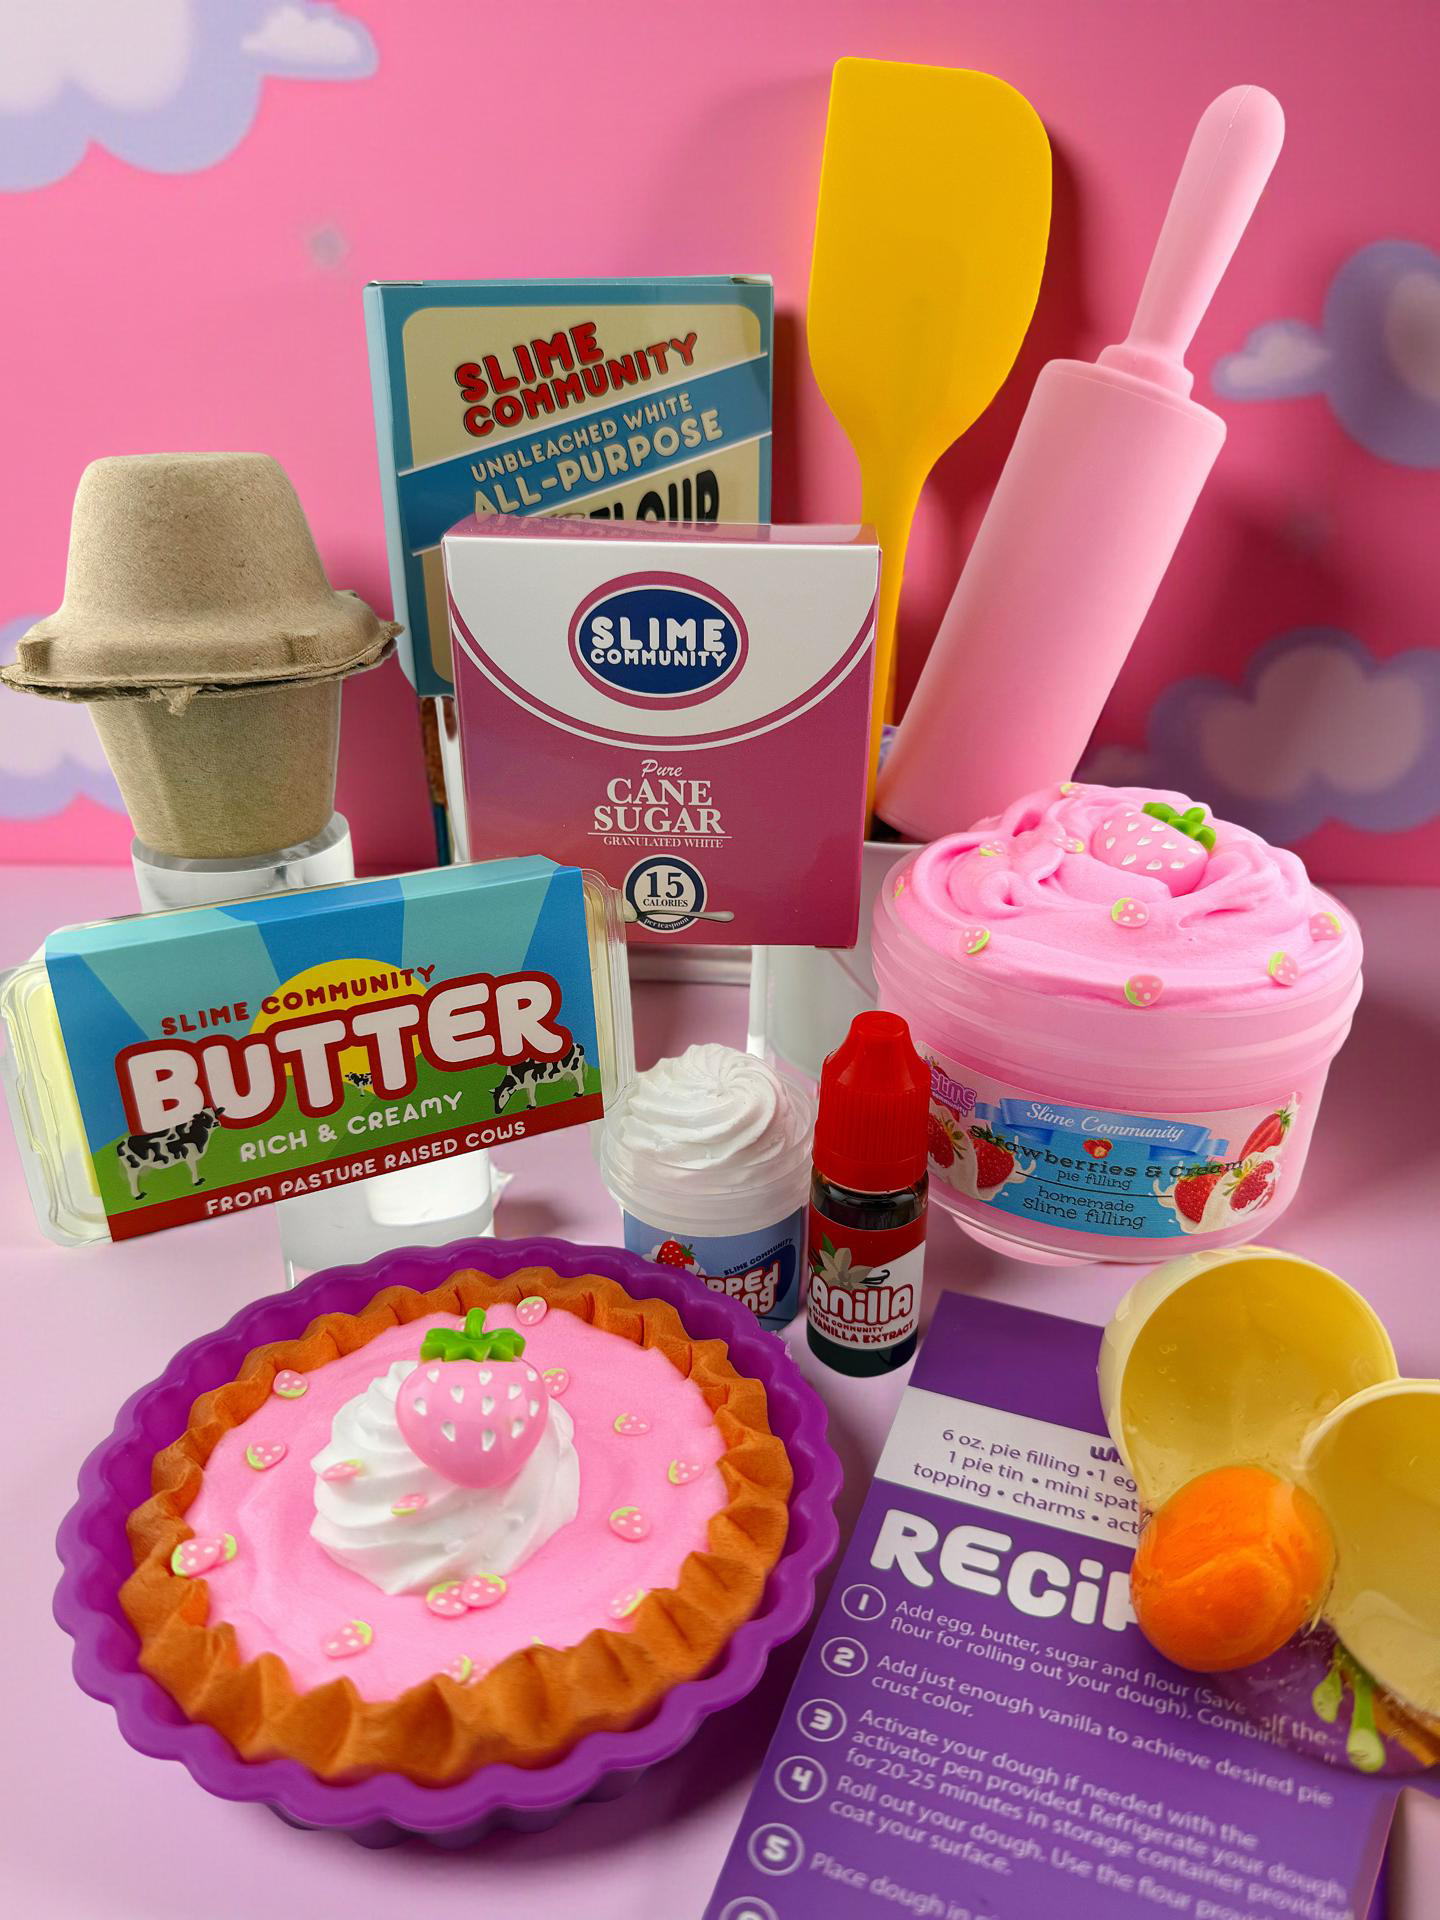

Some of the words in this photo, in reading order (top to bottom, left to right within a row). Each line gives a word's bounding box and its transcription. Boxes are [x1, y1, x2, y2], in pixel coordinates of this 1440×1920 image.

[455, 322, 604, 403] SLIME
[464, 332, 698, 437] COMMUNITY
[471, 419, 618, 483] UNBLEACHED
[623, 393, 693, 431] WHITE
[474, 409, 723, 522] ALL-PURPOSE
[591, 616, 726, 652] SLIME
[591, 648, 727, 668] COMMUNITY
[606, 777, 712, 806] CANE
[641, 758, 683, 778] Pure
[593, 805, 726, 834] SUGAR
[603, 836, 681, 848] GRANULATED
[684, 838, 723, 849] WHITE
[643, 898, 689, 907] CALORIES
[646, 871, 685, 899] 15
[644, 917, 657, 928] per
[657, 916, 690, 930] teaspoon
[162, 1001, 249, 1036] SLIME
[261, 964, 438, 1015] COMMUNITY
[122, 976, 567, 1135] BUTTER
[240, 1128, 308, 1163] RICH
[318, 1119, 336, 1141] &
[346, 1091, 464, 1135] CREAMY
[969, 1124, 1139, 1178] Strawberries
[1145, 1164, 1163, 1178] &
[1169, 1159, 1244, 1179] Cream
[1026, 1102, 1075, 1129] Slime
[1080, 1116, 1186, 1142] Community
[205, 1185, 273, 1216] FROM
[280, 1158, 377, 1197] PASTURE
[384, 1138, 458, 1170] RAISED
[465, 1121, 527, 1150] COWS
[1037, 1185, 1135, 1212] homemade
[1056, 1169, 1081, 1184] pie
[1085, 1172, 1134, 1191] filling
[1022, 1197, 1079, 1222] slime
[1085, 1207, 1147, 1231] filling
[723, 1262, 748, 1276] SLIME
[750, 1238, 794, 1264] COMMUNITY
[812, 1304, 830, 1322] SLIME
[831, 1319, 884, 1333] COMMUNITY
[813, 1315, 859, 1343] VANILLA
[862, 1319, 914, 1344] EXTRACT
[942, 1429, 954, 1442] 6
[958, 1434, 986, 1450] oz.
[990, 1439, 1021, 1459] pie
[1026, 1450, 1081, 1477] filling
[1113, 1474, 1137, 1492] eg
[948, 1451, 957, 1464] 1
[961, 1456, 993, 1476] pie
[998, 1464, 1024, 1482] tin
[1045, 1476, 1090, 1499] mini
[1094, 1490, 1138, 1513] spat
[913, 1462, 992, 1497] topping
[1012, 1490, 1086, 1521] charms
[890, 1616, 933, 1642] flour
[936, 1630, 961, 1651] for
[966, 1640, 1026, 1671] rolling
[1031, 1660, 1063, 1681] out
[1066, 1671, 1110, 1694] your
[1116, 1685, 1193, 1720] dough).
[895, 1600, 934, 1622] Add
[938, 1614, 976, 1636] egg,
[980, 1623, 1040, 1656] butter,
[1046, 1645, 1099, 1673] sugar
[1101, 1659, 1140, 1683] and
[1144, 1672, 1189, 1697] flour
[1195, 1686, 1248, 1715] (Save
[871, 1675, 919, 1700] crust
[922, 1689, 974, 1718] color.
[832, 1646, 856, 1667] 2
[877, 1655, 916, 1678] Add
[920, 1667, 956, 1691] just
[959, 1681, 1034, 1716] enough
[1039, 1705, 1102, 1737] vanilla
[1107, 1725, 1128, 1744] to
[1131, 1733, 1211, 1769] achieve
[1215, 1758, 1294, 1796] desired
[1297, 1784, 1335, 1808] pie
[809, 1707, 833, 1731] 3
[859, 1709, 939, 1747] Activate
[942, 1735, 988, 1764] your
[992, 1753, 1060, 1788] dough
[1064, 1771, 1080, 1792] if
[1081, 1780, 1163, 1819] needed
[1167, 1808, 1216, 1838] with
[1220, 1822, 1259, 1850] the
[852, 1731, 940, 1769] activator
[943, 1761, 982, 1786] pen
[1090, 1802, 1208, 1858] Refrigerate
[1212, 1846, 1265, 1877] your
[790, 1766, 813, 1792] 4
[837, 1774, 876, 1802] Roll
[879, 1794, 915, 1817] out
[918, 1806, 967, 1835] your
[969, 1823, 1047, 1863] dough.
[1051, 1846, 1093, 1878] Use
[1096, 1862, 1135, 1891] the
[1137, 1874, 1192, 1910] flour
[830, 1800, 876, 1827] coat
[878, 1816, 927, 1844] your
[930, 1835, 1013, 1876] surface.
[847, 1747, 873, 1770] for
[877, 1761, 935, 1790] 20-25
[939, 1783, 1022, 1822] minutes
[1027, 1808, 1048, 1830] in
[1052, 1816, 1134, 1858] storage
[1136, 1846, 1244, 1894] container
[763, 1834, 790, 1862] 5
[810, 1852, 867, 1889] Place
[870, 1876, 944, 1918] dough
